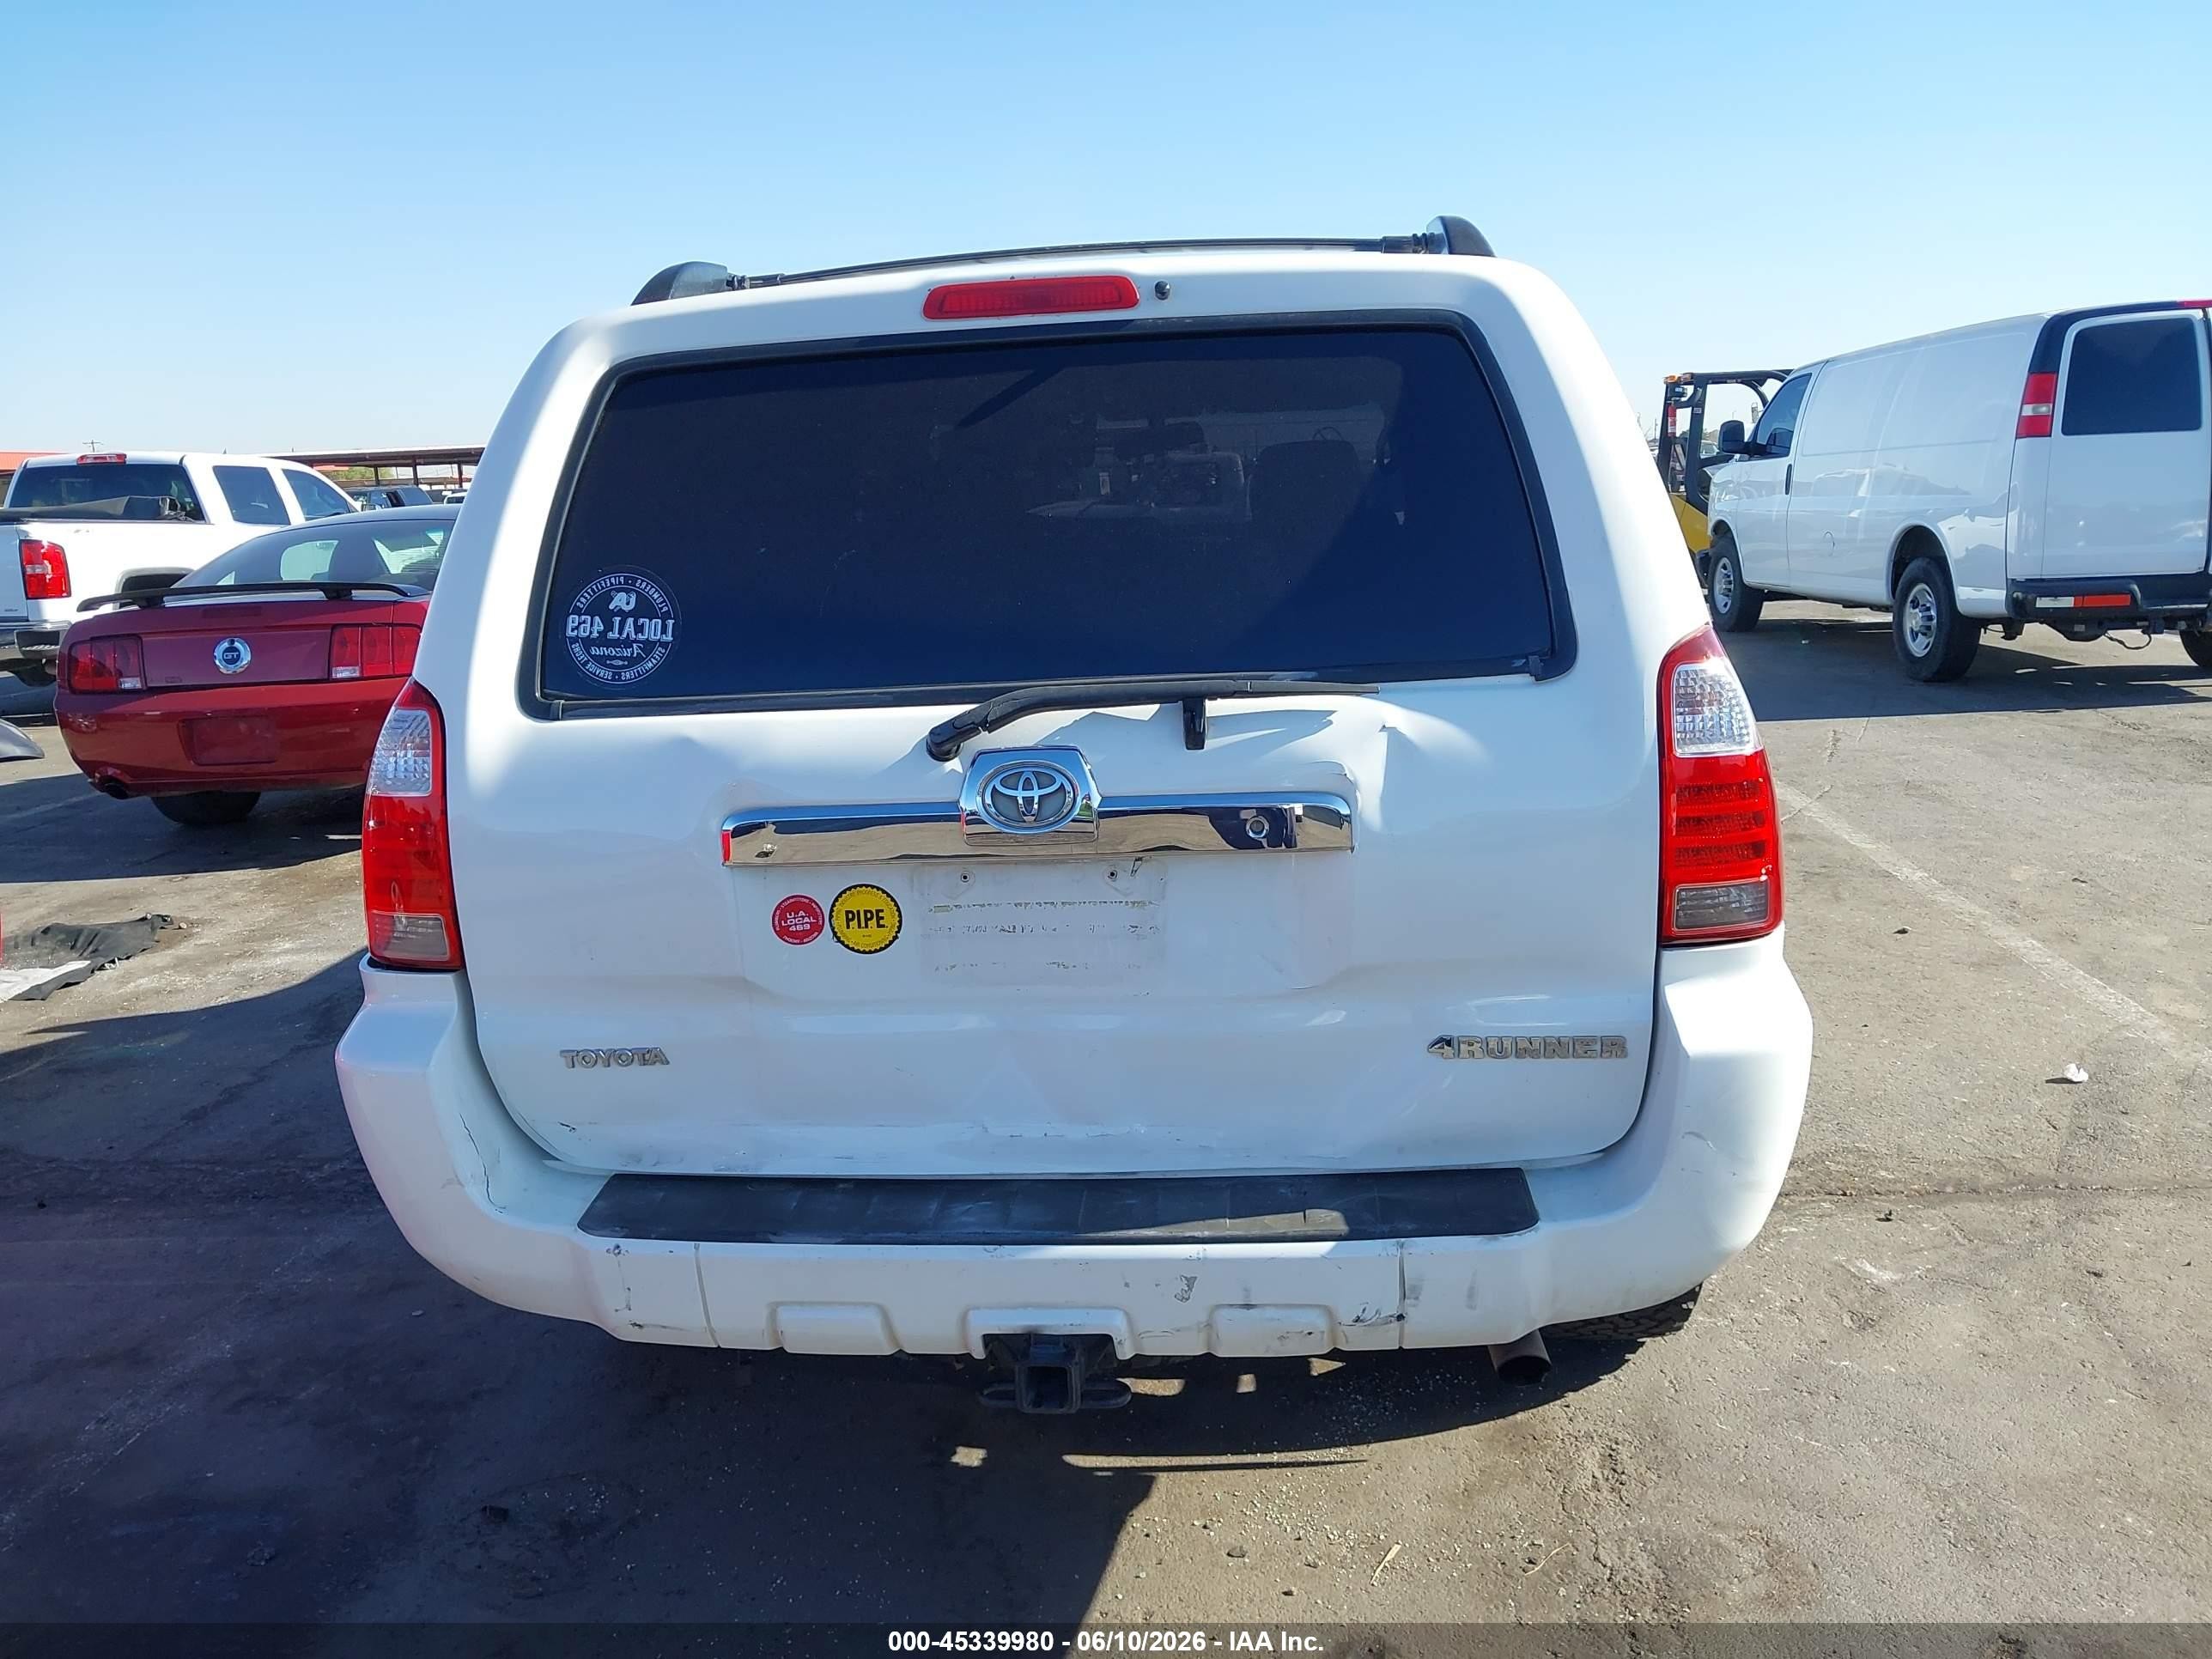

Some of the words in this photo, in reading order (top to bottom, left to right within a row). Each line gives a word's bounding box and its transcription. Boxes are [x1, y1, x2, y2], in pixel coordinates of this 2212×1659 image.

[781, 916, 817, 927] LOCAL
[845, 908, 889, 930] P.I.P.E.
[559, 1047, 670, 1069] TOYOTA
[1427, 1035, 1628, 1060] 4RUNNER
